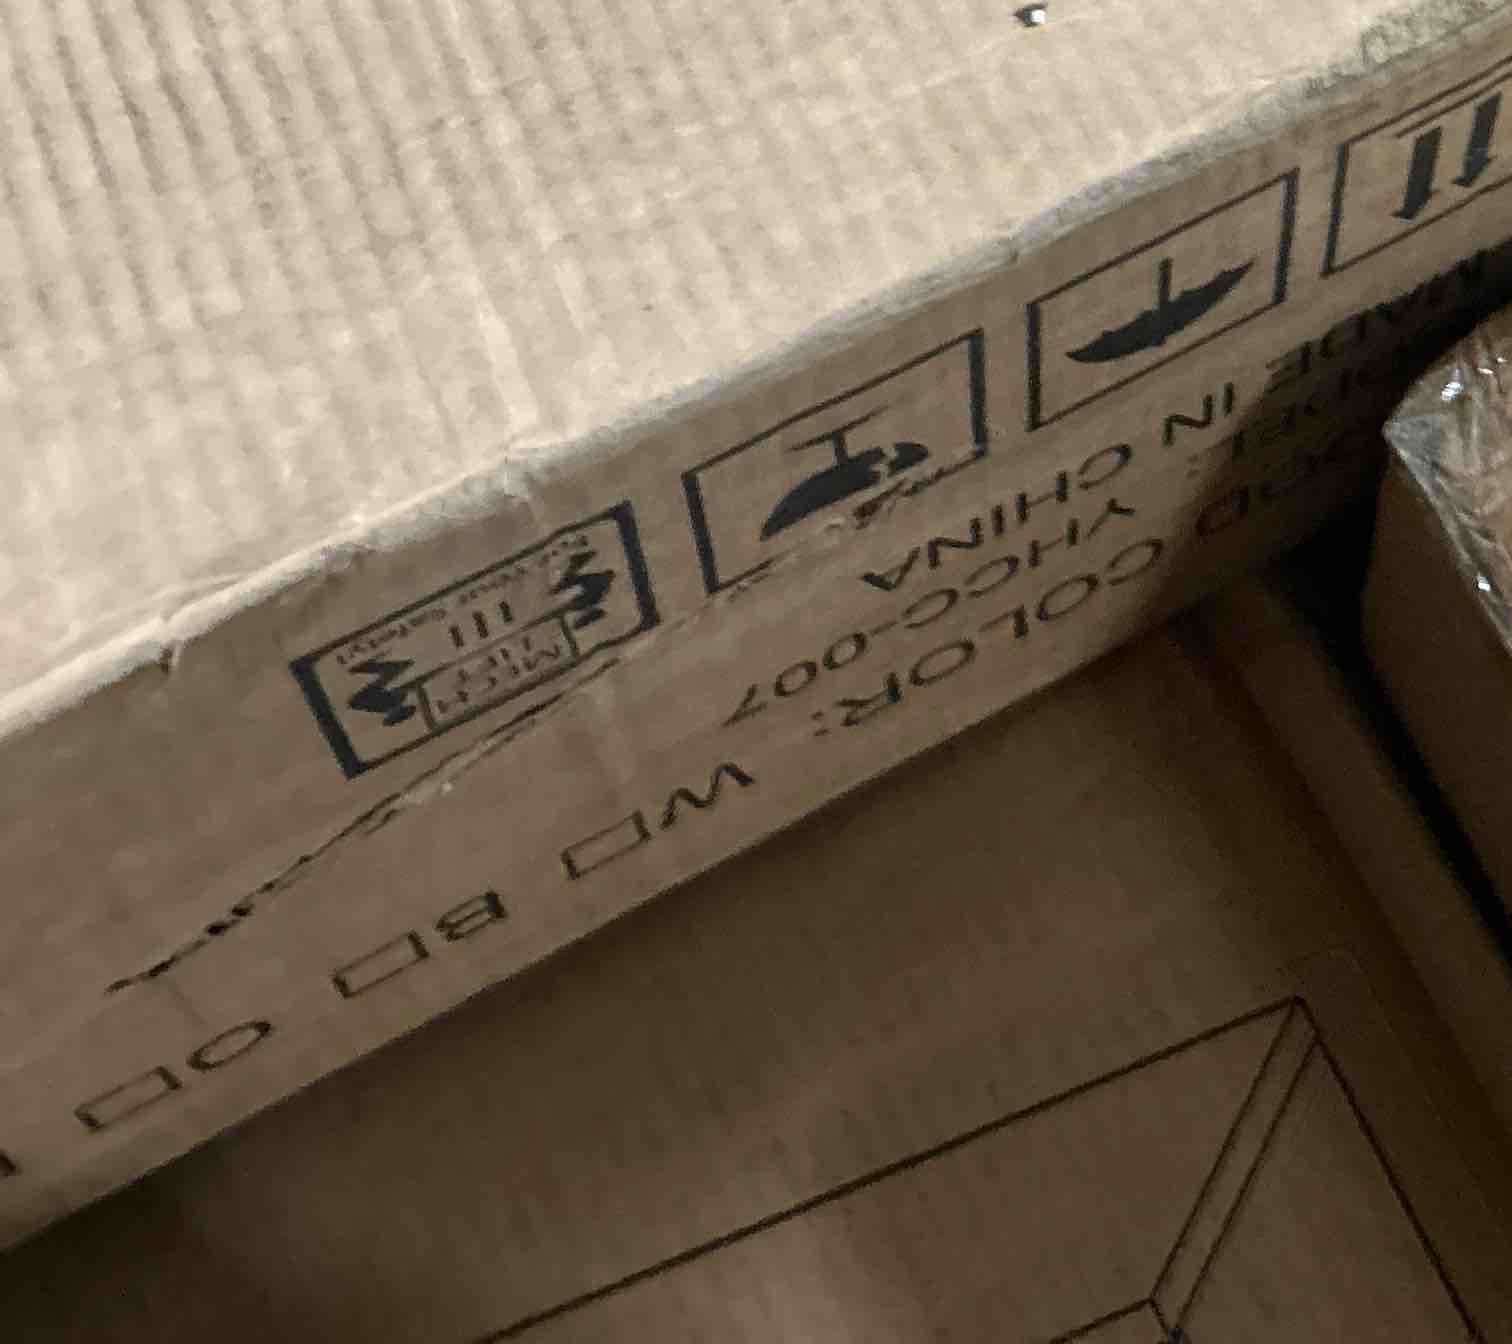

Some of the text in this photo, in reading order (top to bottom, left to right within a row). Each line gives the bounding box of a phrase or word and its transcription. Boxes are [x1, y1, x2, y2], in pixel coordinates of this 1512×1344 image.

[1161, 382, 1235, 446] IN
[861, 444, 1131, 592] CHINA
[722, 498, 1136, 726] YHCC-007
[813, 537, 1165, 736] COLOR:
